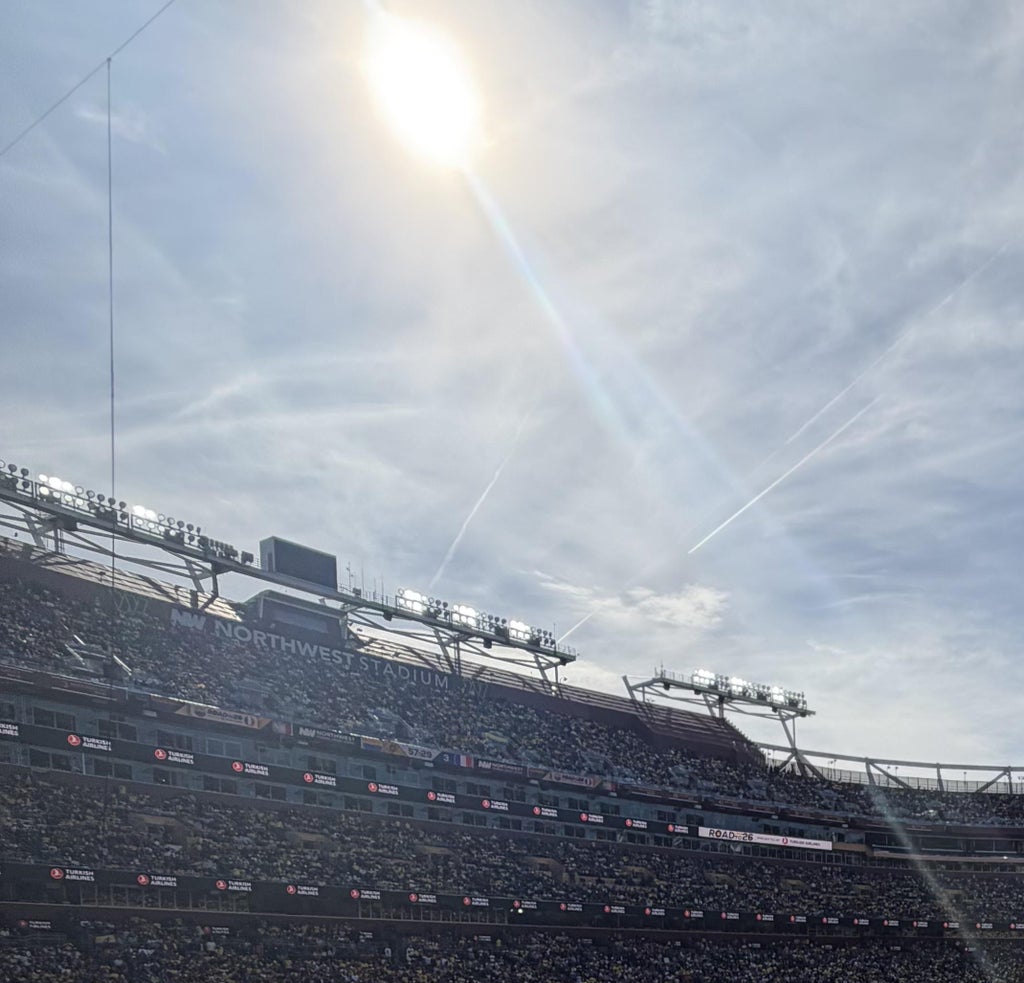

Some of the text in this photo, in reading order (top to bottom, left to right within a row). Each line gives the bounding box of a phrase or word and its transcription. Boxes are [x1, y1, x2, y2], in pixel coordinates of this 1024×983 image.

[213, 620, 355, 667] NORTHWEST
[360, 656, 449, 689] STADIUM
[83, 736, 112, 746] TURKISH
[82, 742, 112, 751] AIRLINES
[168, 750, 194, 759] TURKISH
[443, 753, 450, 761] 3
[709, 829, 734, 840] ROAD
[742, 833, 754, 841] 26
